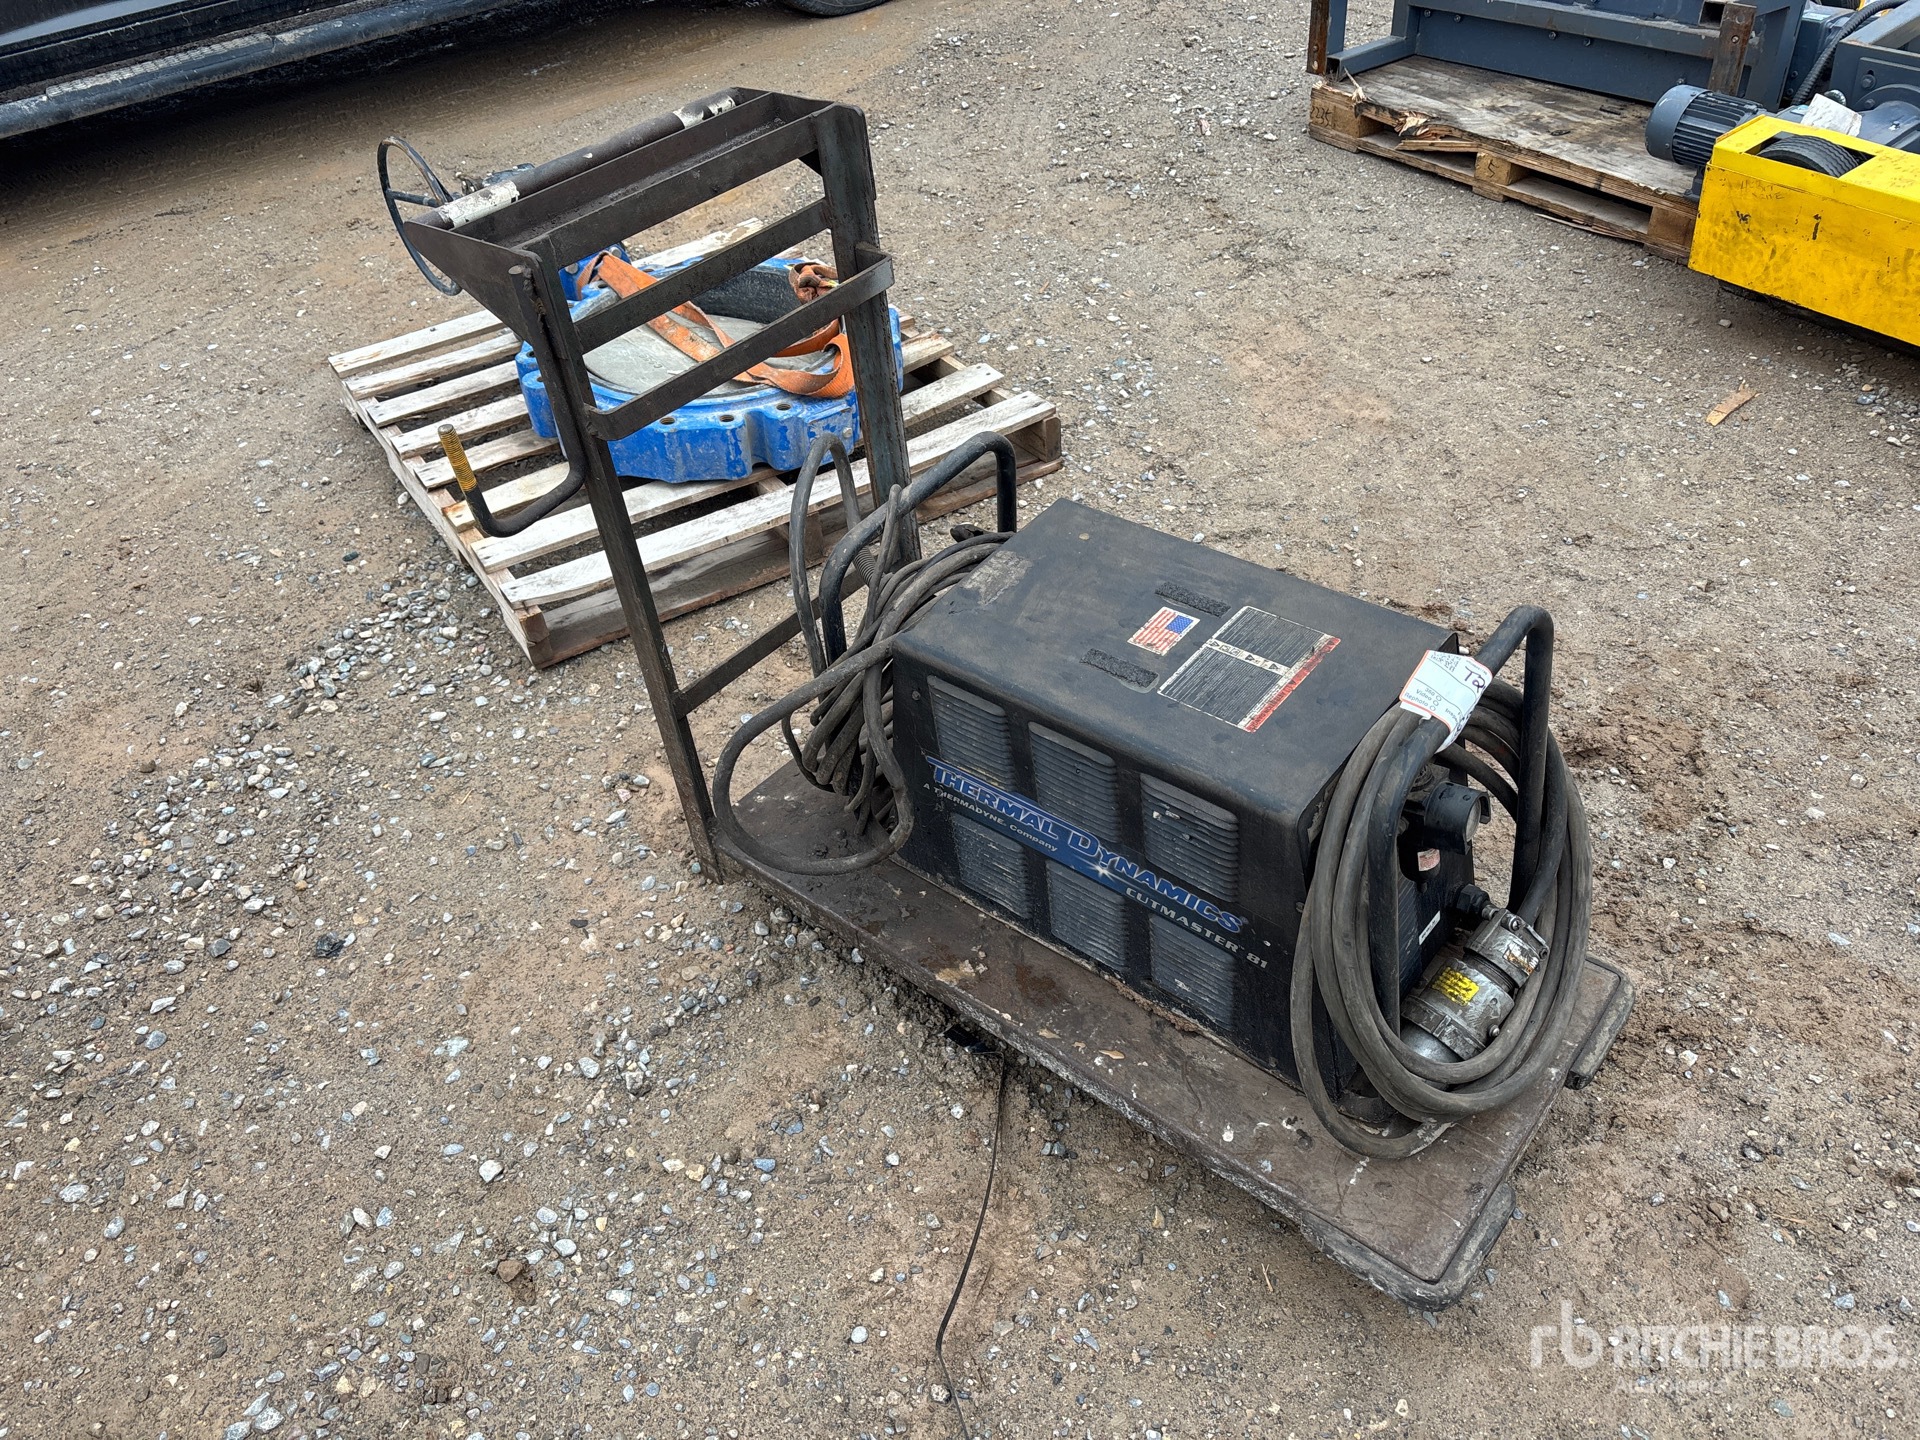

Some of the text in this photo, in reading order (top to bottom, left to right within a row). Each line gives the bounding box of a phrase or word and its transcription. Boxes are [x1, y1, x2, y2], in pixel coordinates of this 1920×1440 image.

[923, 782, 930, 790] A
[1009, 824, 1058, 852] Company
[932, 763, 1243, 934] THERMAL DYNAMICS
[1246, 952, 1268, 969] 81
